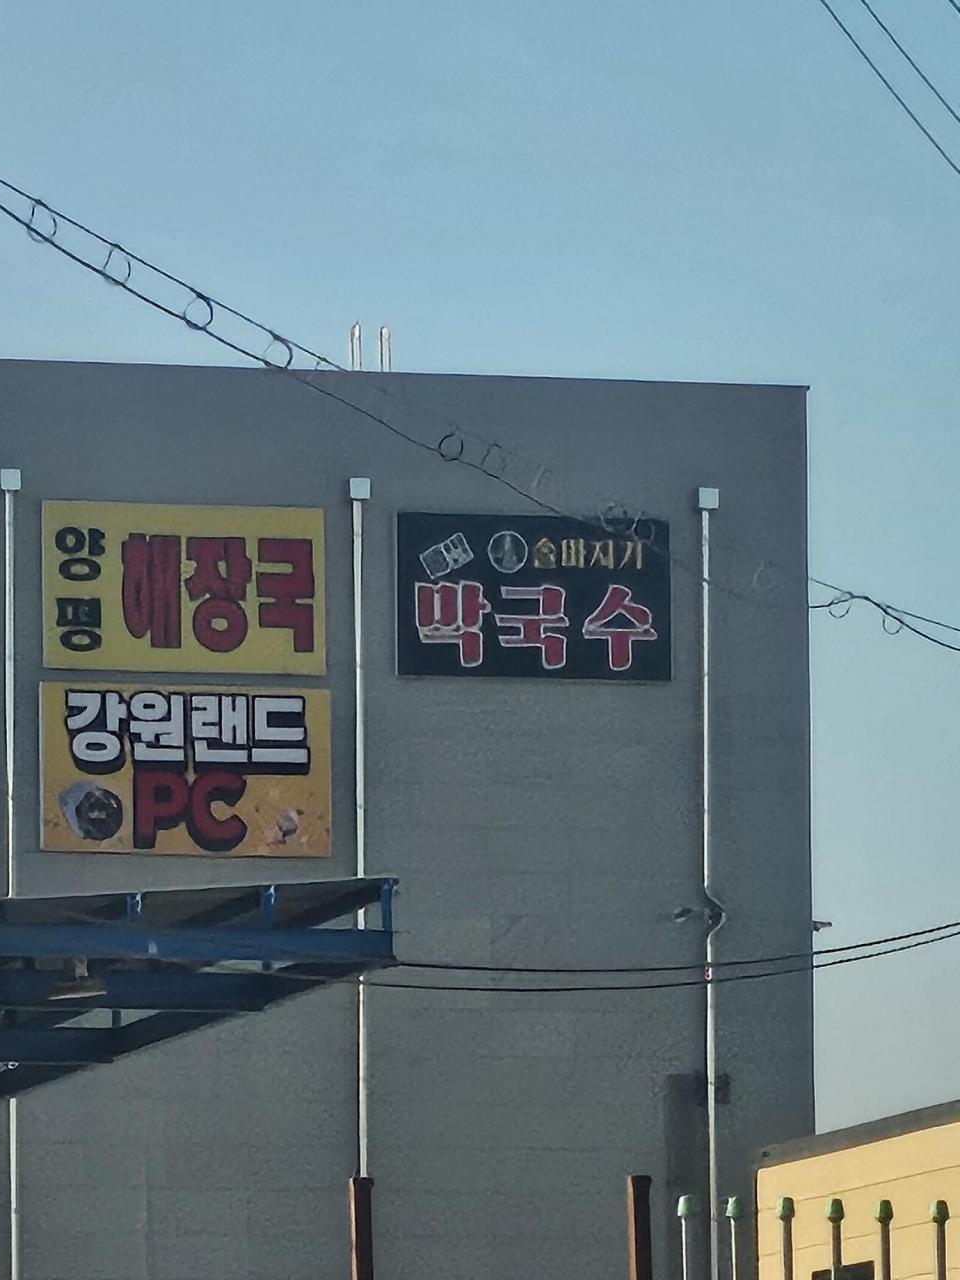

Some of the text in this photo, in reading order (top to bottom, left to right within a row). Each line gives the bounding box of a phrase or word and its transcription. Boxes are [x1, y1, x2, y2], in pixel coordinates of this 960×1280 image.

[54, 526, 105, 652] 양평
[414, 580, 658, 671] 막국수
[65, 689, 310, 774] 강원랜드
[132, 770, 248, 852] PC
